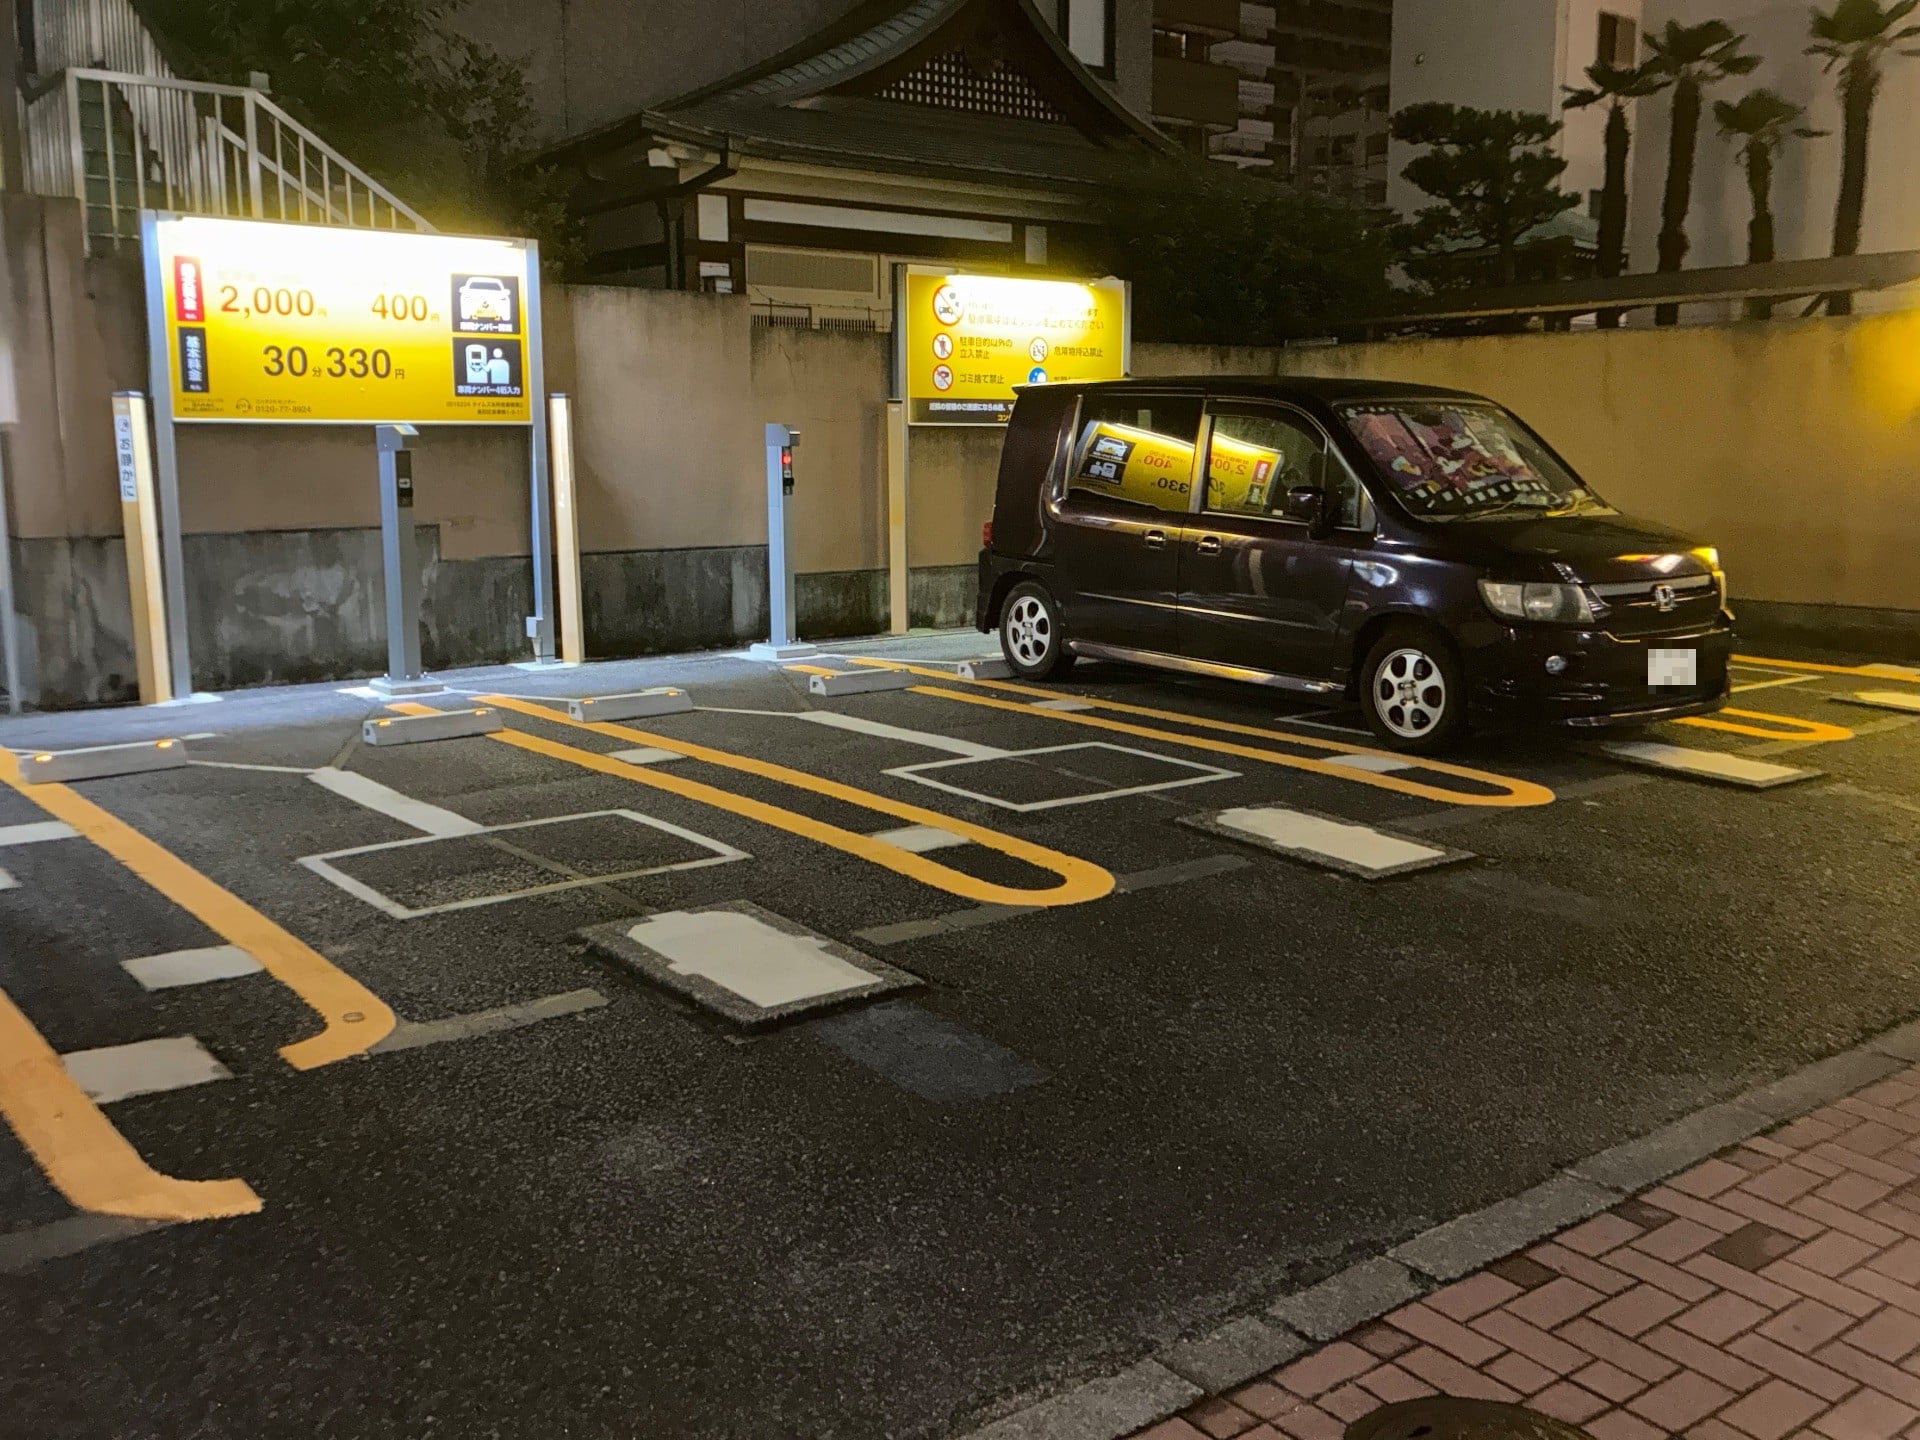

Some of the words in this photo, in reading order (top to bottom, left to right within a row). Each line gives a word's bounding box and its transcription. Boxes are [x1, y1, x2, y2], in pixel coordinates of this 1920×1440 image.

[959, 348, 990, 360] 立入禁止
[1053, 346, 1104, 358] 危険物持込禁止
[959, 373, 1005, 385] ゴミ捨て禁止
